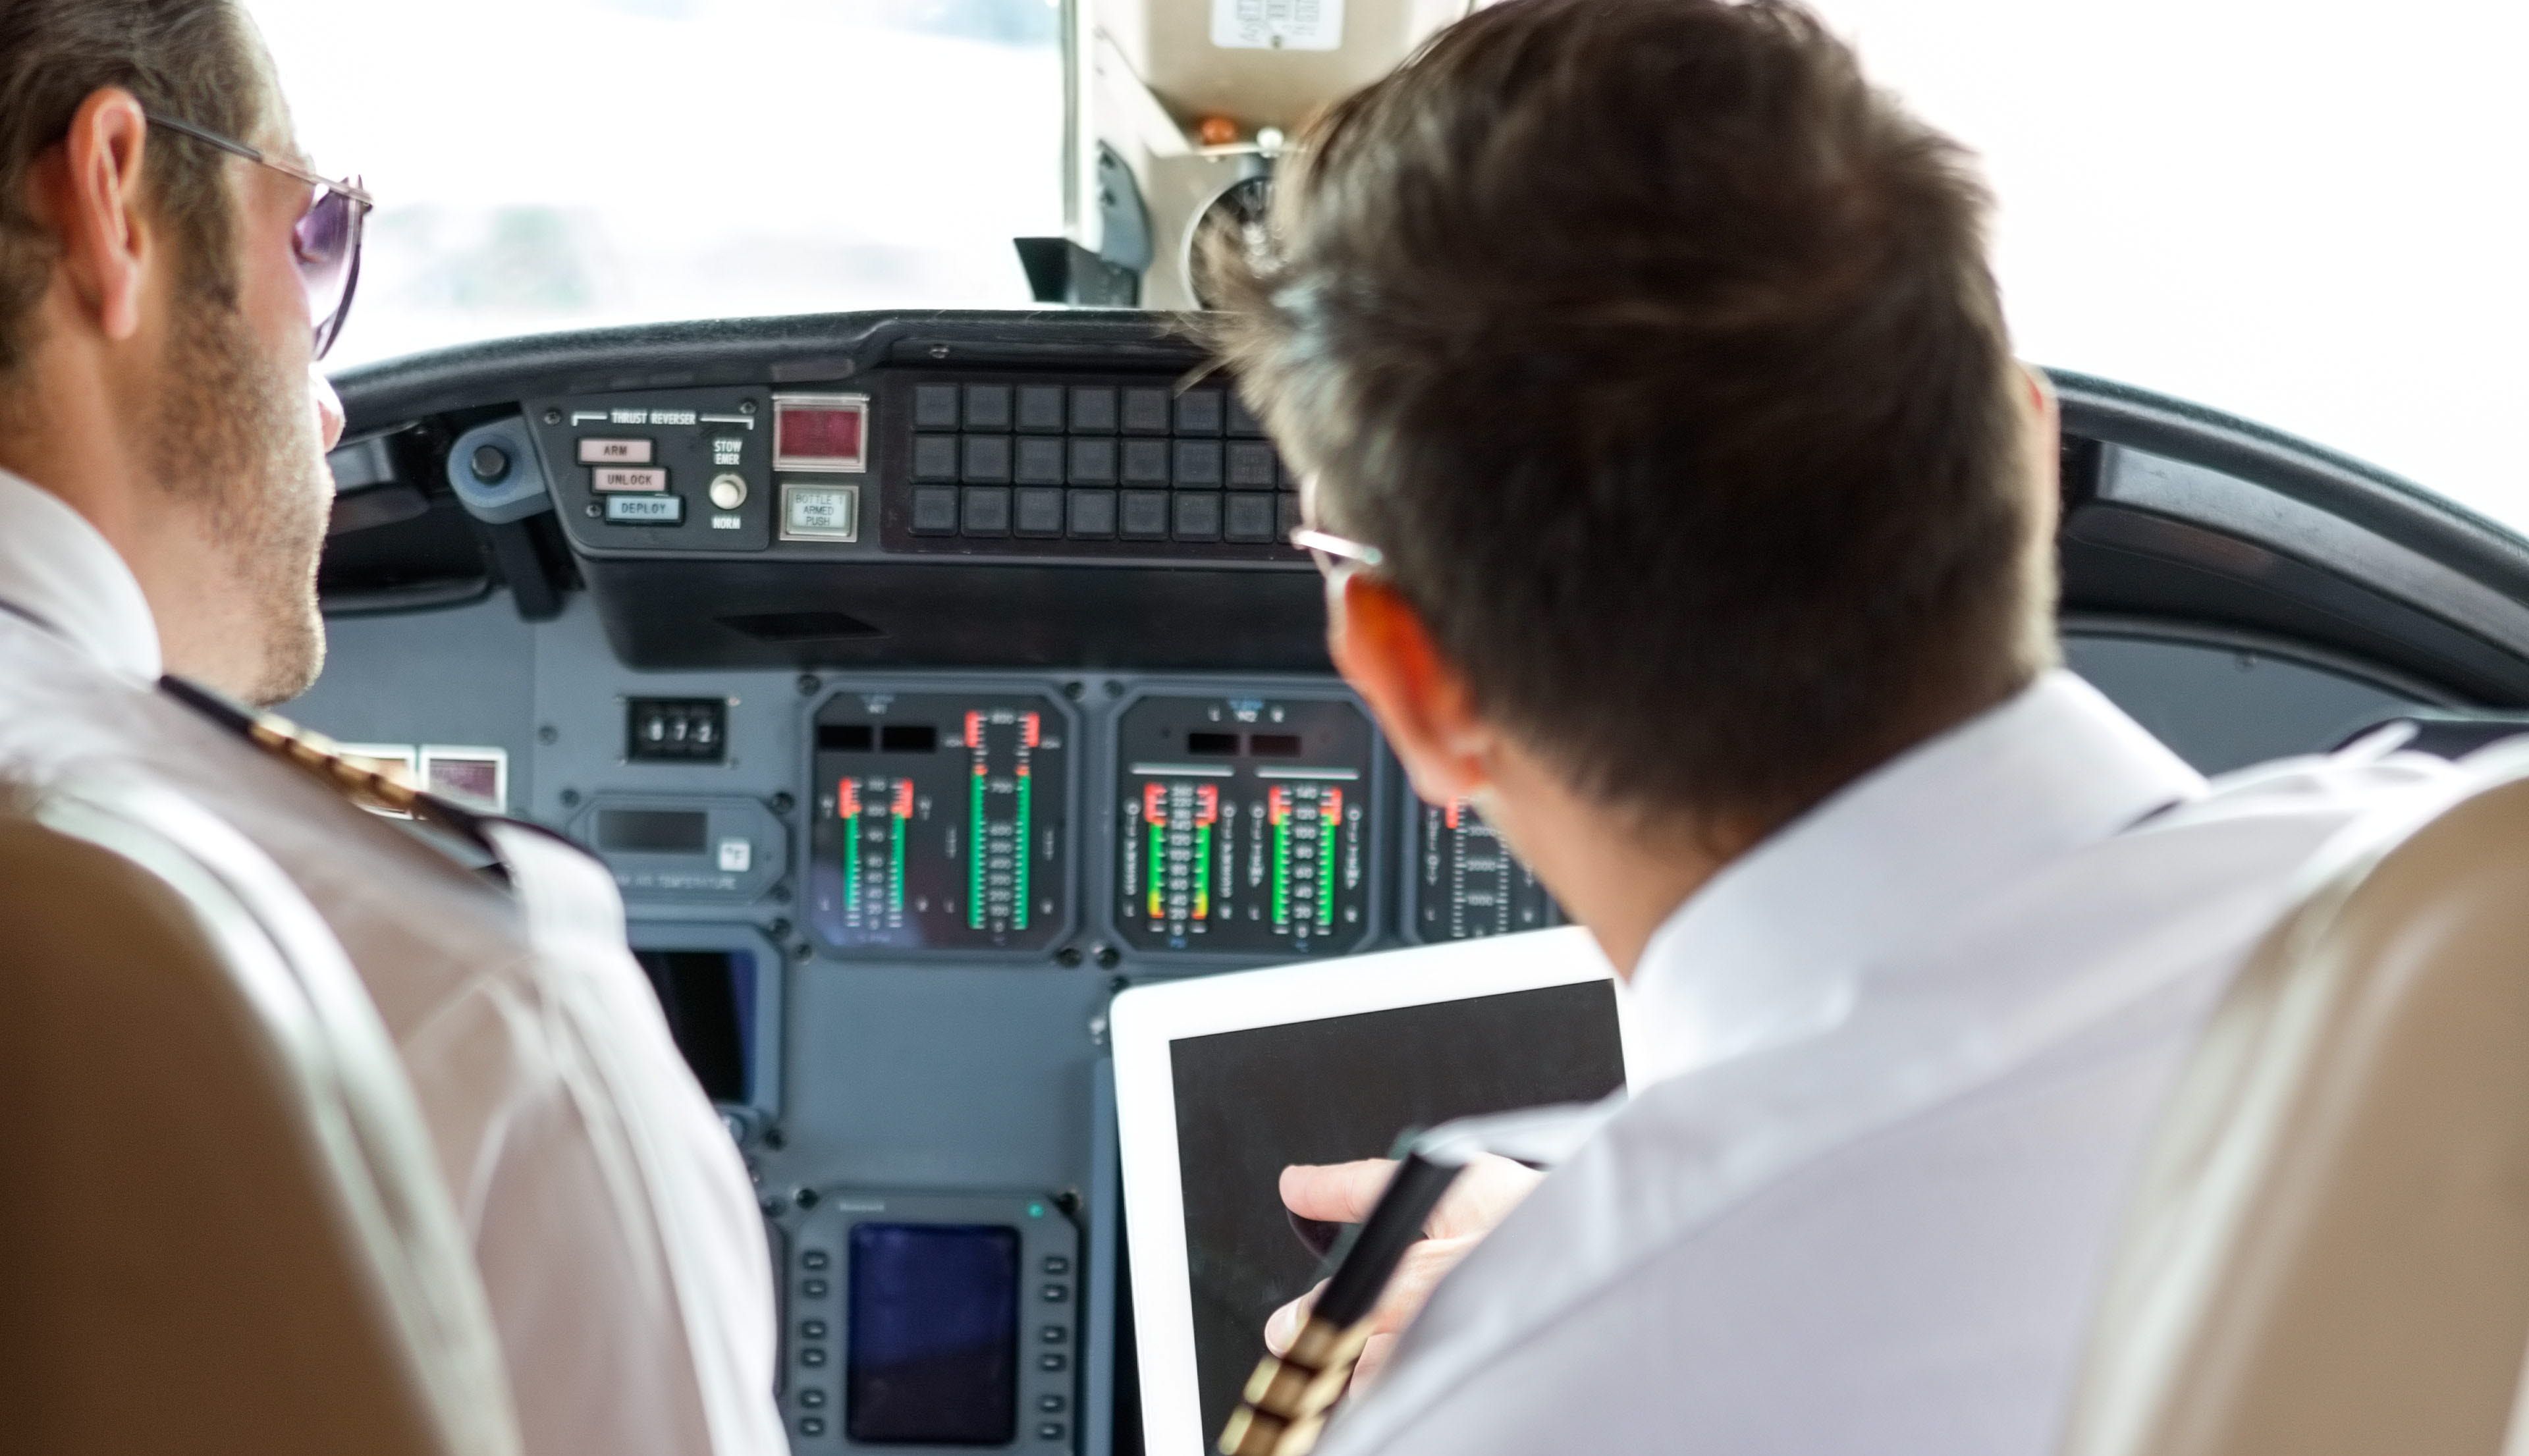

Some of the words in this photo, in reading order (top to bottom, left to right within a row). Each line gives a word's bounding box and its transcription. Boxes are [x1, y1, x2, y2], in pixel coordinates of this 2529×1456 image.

[611, 411, 647, 424] THRUST
[650, 411, 696, 425] REVERSER
[603, 445, 628, 457] ARM
[714, 439, 742, 453] STOW
[715, 453, 740, 465] EMER
[607, 473, 652, 486] UNLOCK
[796, 494, 832, 505] BOTTLE
[621, 502, 666, 514] DEPLOY
[803, 505, 834, 516] ARMED
[713, 516, 741, 529] NORM
[805, 516, 830, 526] PUSH
